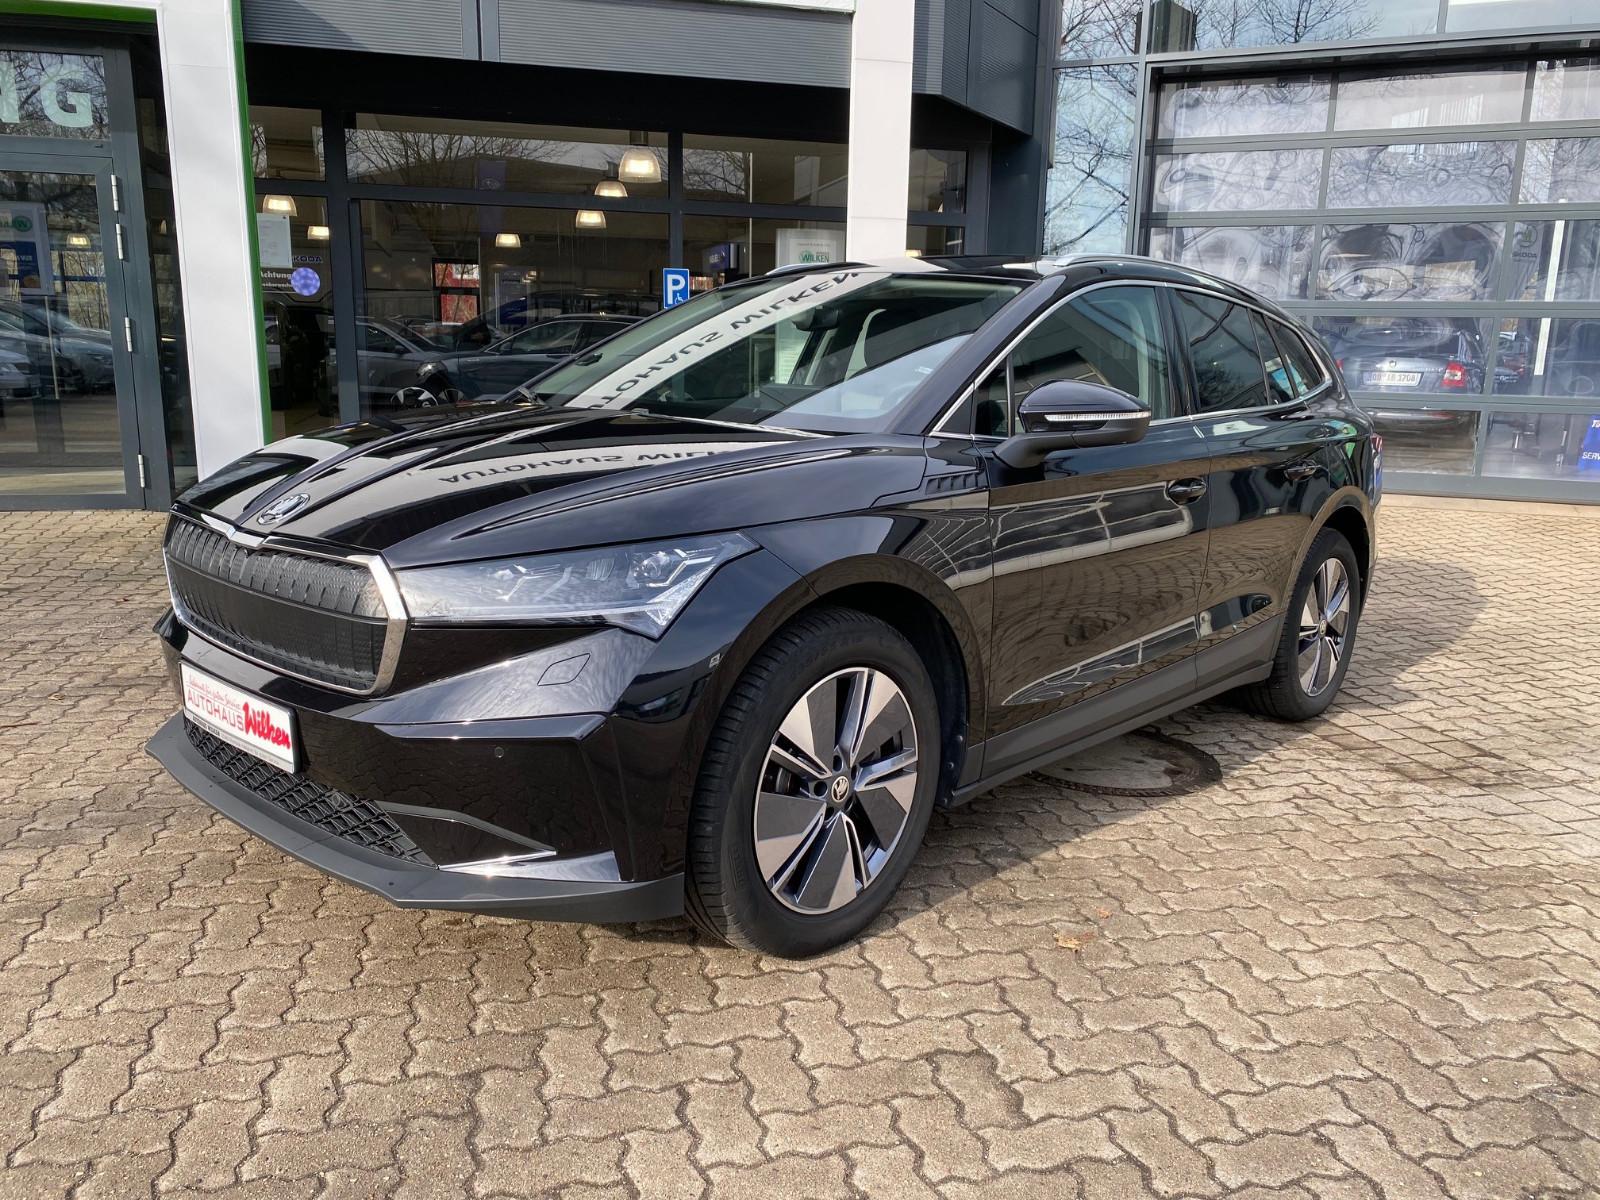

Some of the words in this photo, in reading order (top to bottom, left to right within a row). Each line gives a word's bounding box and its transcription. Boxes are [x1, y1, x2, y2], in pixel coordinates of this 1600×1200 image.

[667, 274, 685, 304] P
[187, 689, 244, 731] AUTOHAUS
[242, 702, 291, 749] Wilken
